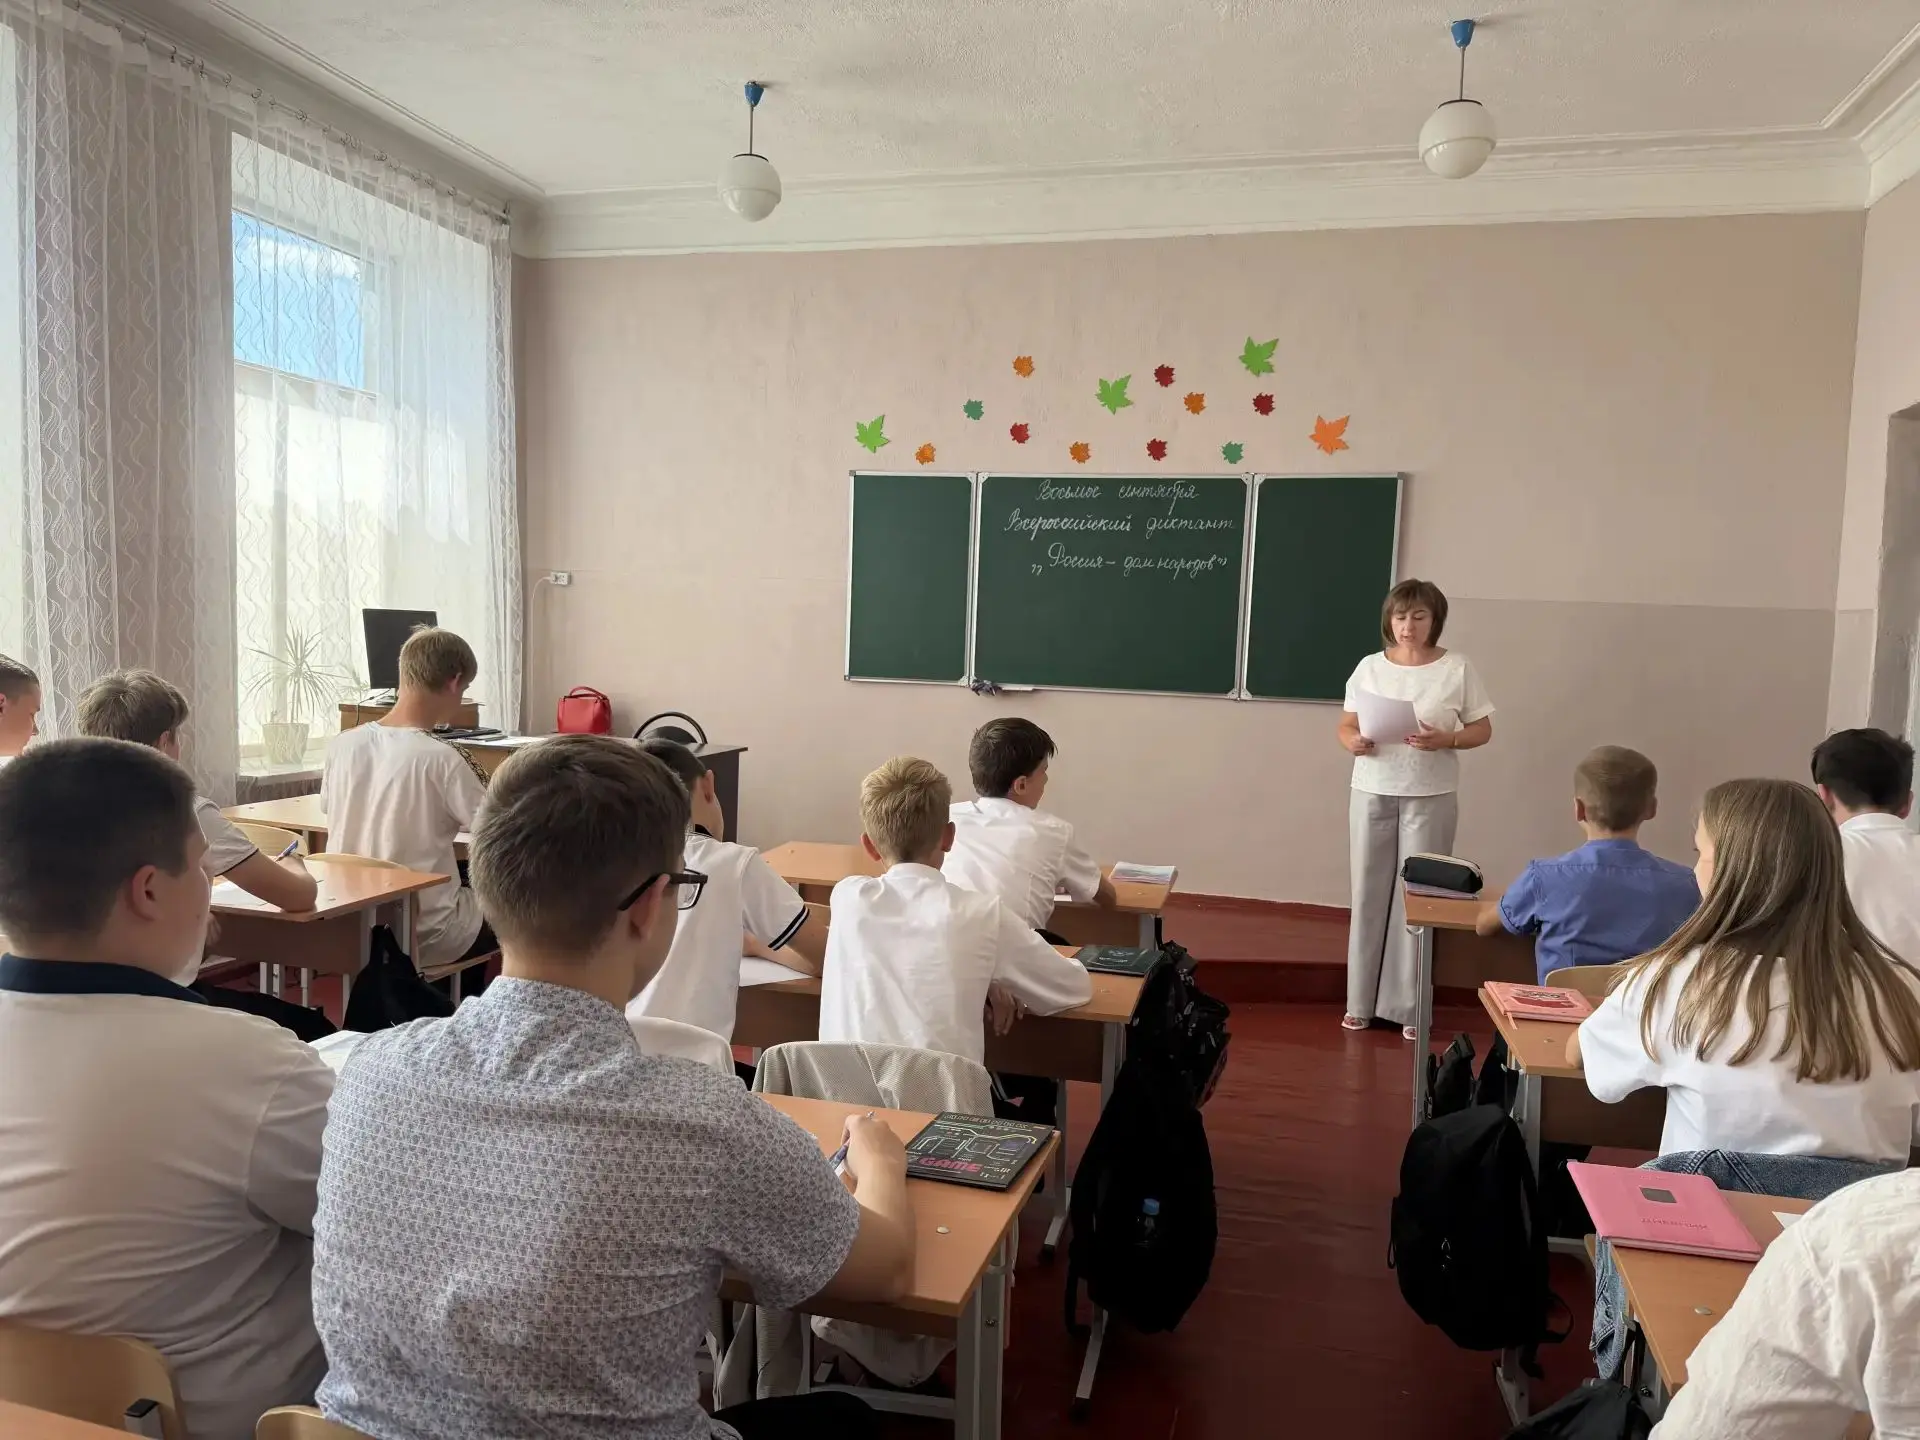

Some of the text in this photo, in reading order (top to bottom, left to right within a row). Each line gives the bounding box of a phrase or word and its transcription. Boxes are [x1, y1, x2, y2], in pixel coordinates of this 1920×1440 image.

[1036, 479, 1104, 501] Восьмое
[1004, 508, 1234, 541] Всероссийский диктант
[1123, 556, 1154, 577] дом
[918, 1157, 983, 1173] GAME
